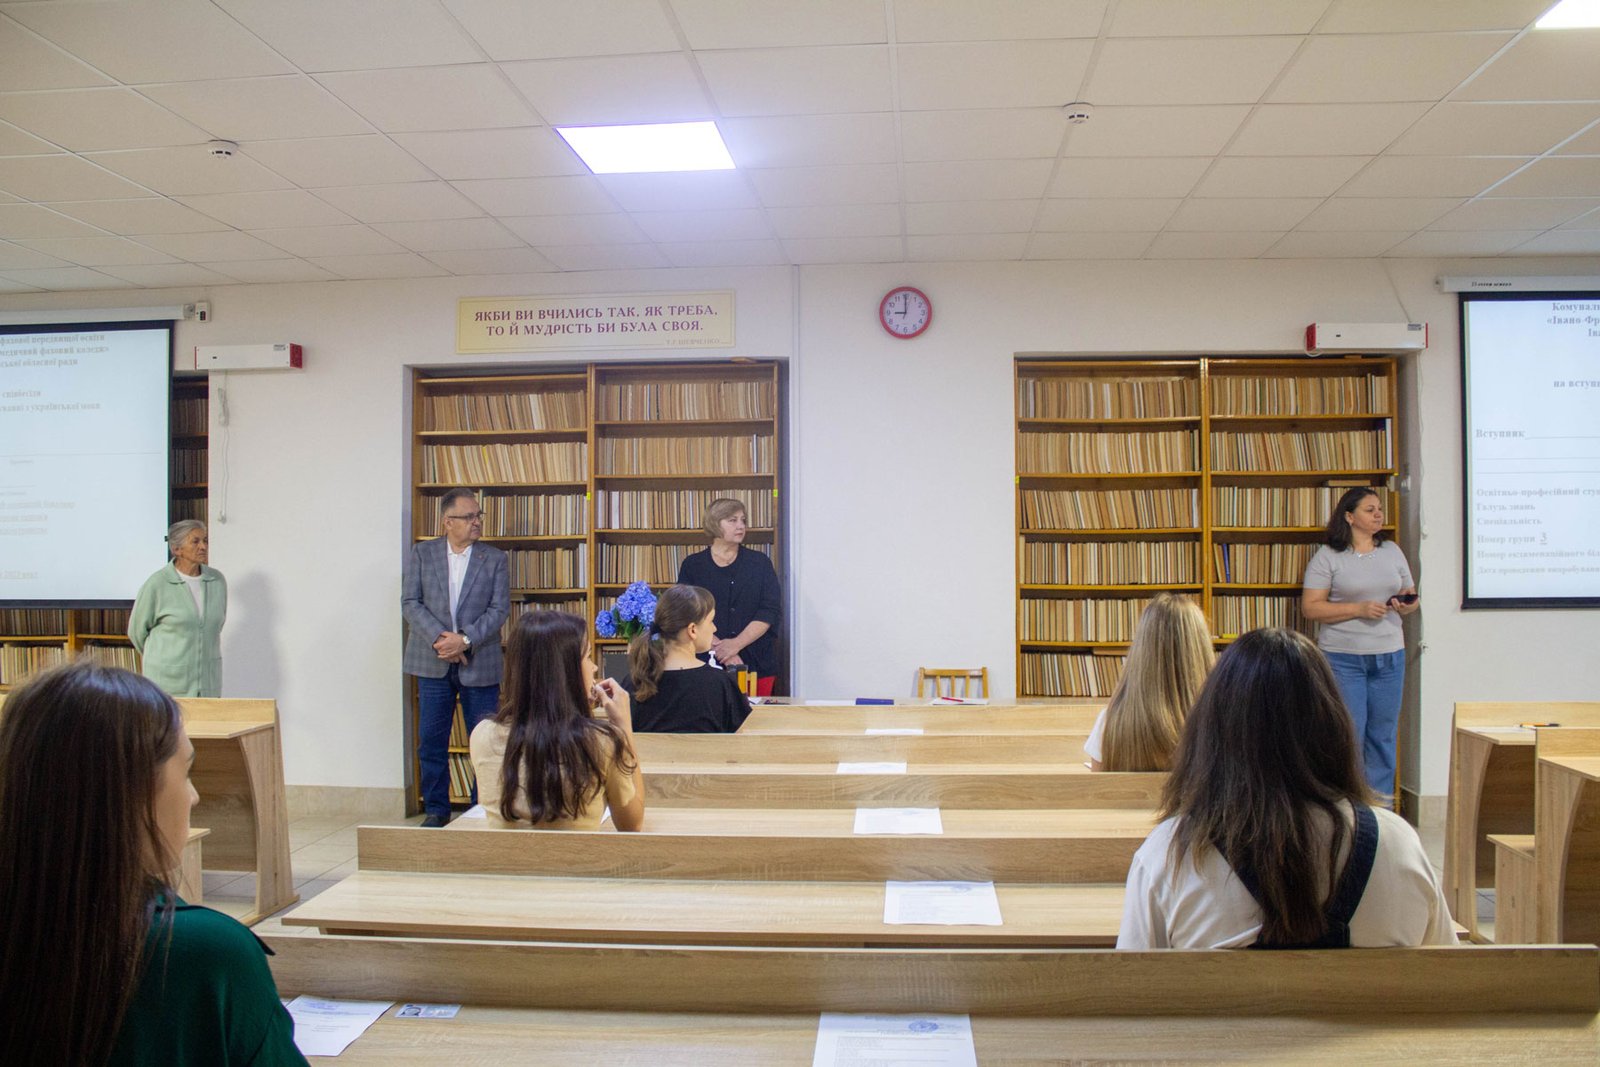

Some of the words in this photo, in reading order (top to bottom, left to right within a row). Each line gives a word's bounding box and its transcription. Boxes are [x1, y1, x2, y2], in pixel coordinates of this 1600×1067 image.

[474, 310, 511, 322] ЯКБИ
[515, 310, 534, 321] ВИ
[538, 308, 603, 320] ВЧИЛИСЬ
[644, 305, 662, 317] ЯК
[486, 325, 505, 336] ТО
[509, 322, 520, 336] Й
[523, 323, 592, 338] МУДРІСТЬ
[597, 322, 616, 334] БИ
[620, 320, 657, 333] БУЛА
[662, 320, 704, 332] СВОЯ.
[1476, 429, 1525, 440] Вступник
